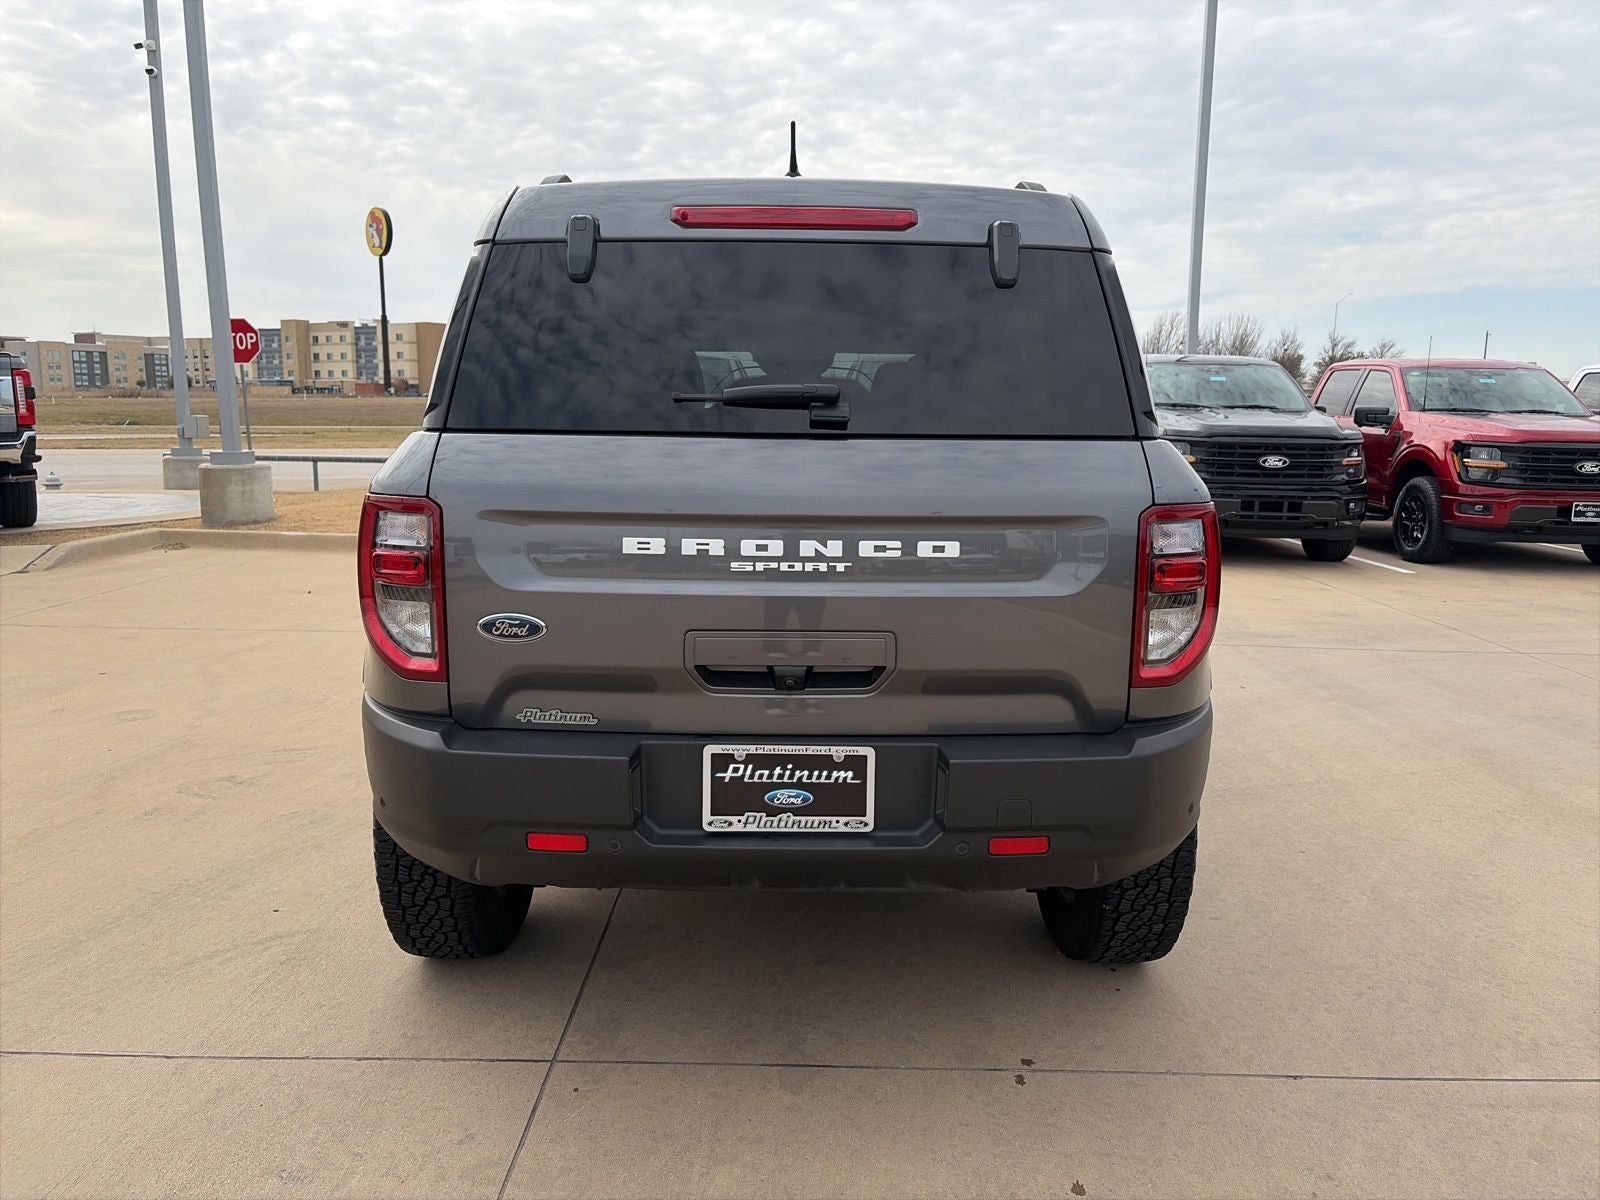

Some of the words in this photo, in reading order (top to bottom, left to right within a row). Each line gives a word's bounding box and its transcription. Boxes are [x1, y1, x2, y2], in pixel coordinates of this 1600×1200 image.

[231, 332, 257, 350] TOP
[622, 536, 961, 558] BRONCO
[729, 561, 853, 573] SPORT
[492, 618, 530, 636] Ford
[515, 706, 599, 726] Platinum
[720, 746, 859, 755] www.PlatinumFord.com
[714, 763, 863, 784] Platinum
[773, 790, 804, 805] Ford
[742, 814, 840, 830] Platinum
